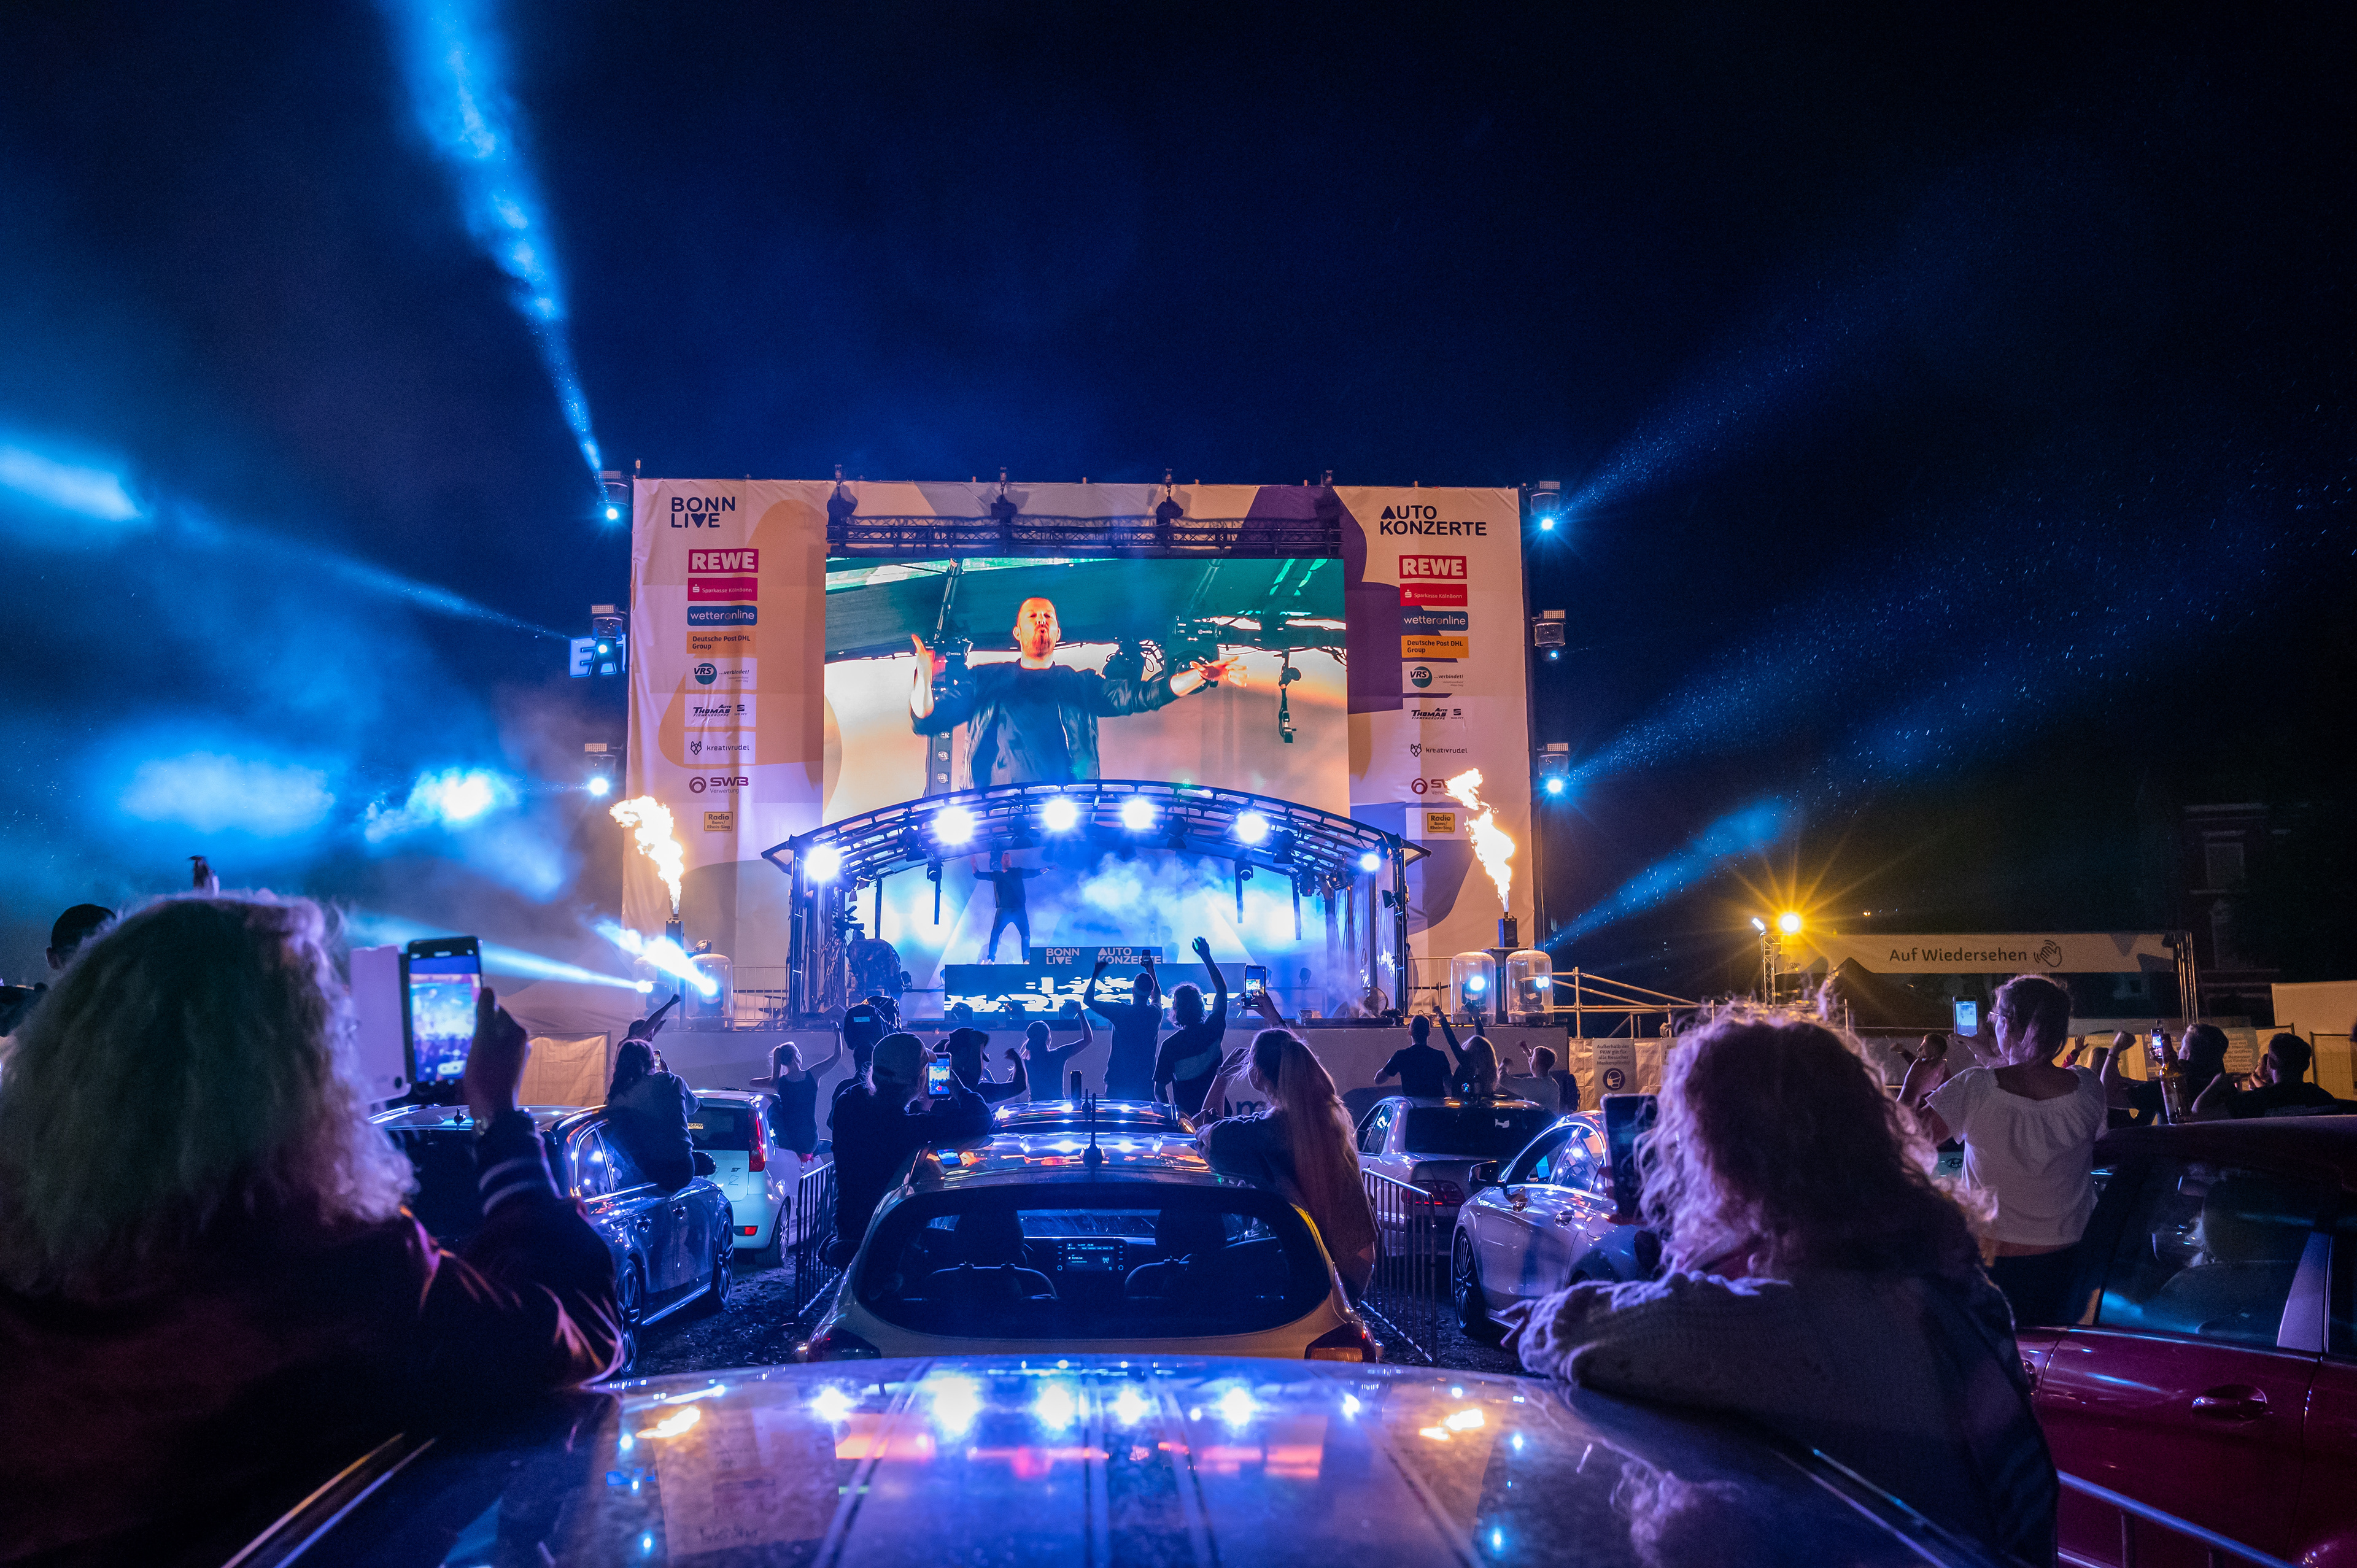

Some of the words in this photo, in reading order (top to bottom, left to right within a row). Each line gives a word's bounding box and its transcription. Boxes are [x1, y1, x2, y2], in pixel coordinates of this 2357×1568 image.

[671, 496, 735, 512] BONN
[1380, 505, 1437, 520] AUTO
[671, 512, 721, 528] LIVE
[1380, 520, 1487, 536] KONZERTE
[692, 552, 755, 570] REWE
[1402, 558, 1464, 576] REWE
[690, 609, 755, 620] wetteronline
[1403, 614, 1466, 625] wetteronline
[710, 776, 749, 787] SWB
[1046, 948, 1080, 957] BONN
[1097, 947, 1132, 956] AUTO
[1889, 948, 1918, 962] Auf
[1922, 948, 2027, 962] Wiedersehen
[1046, 956, 1072, 965] LIVE
[1097, 956, 1162, 965] KONZEE
